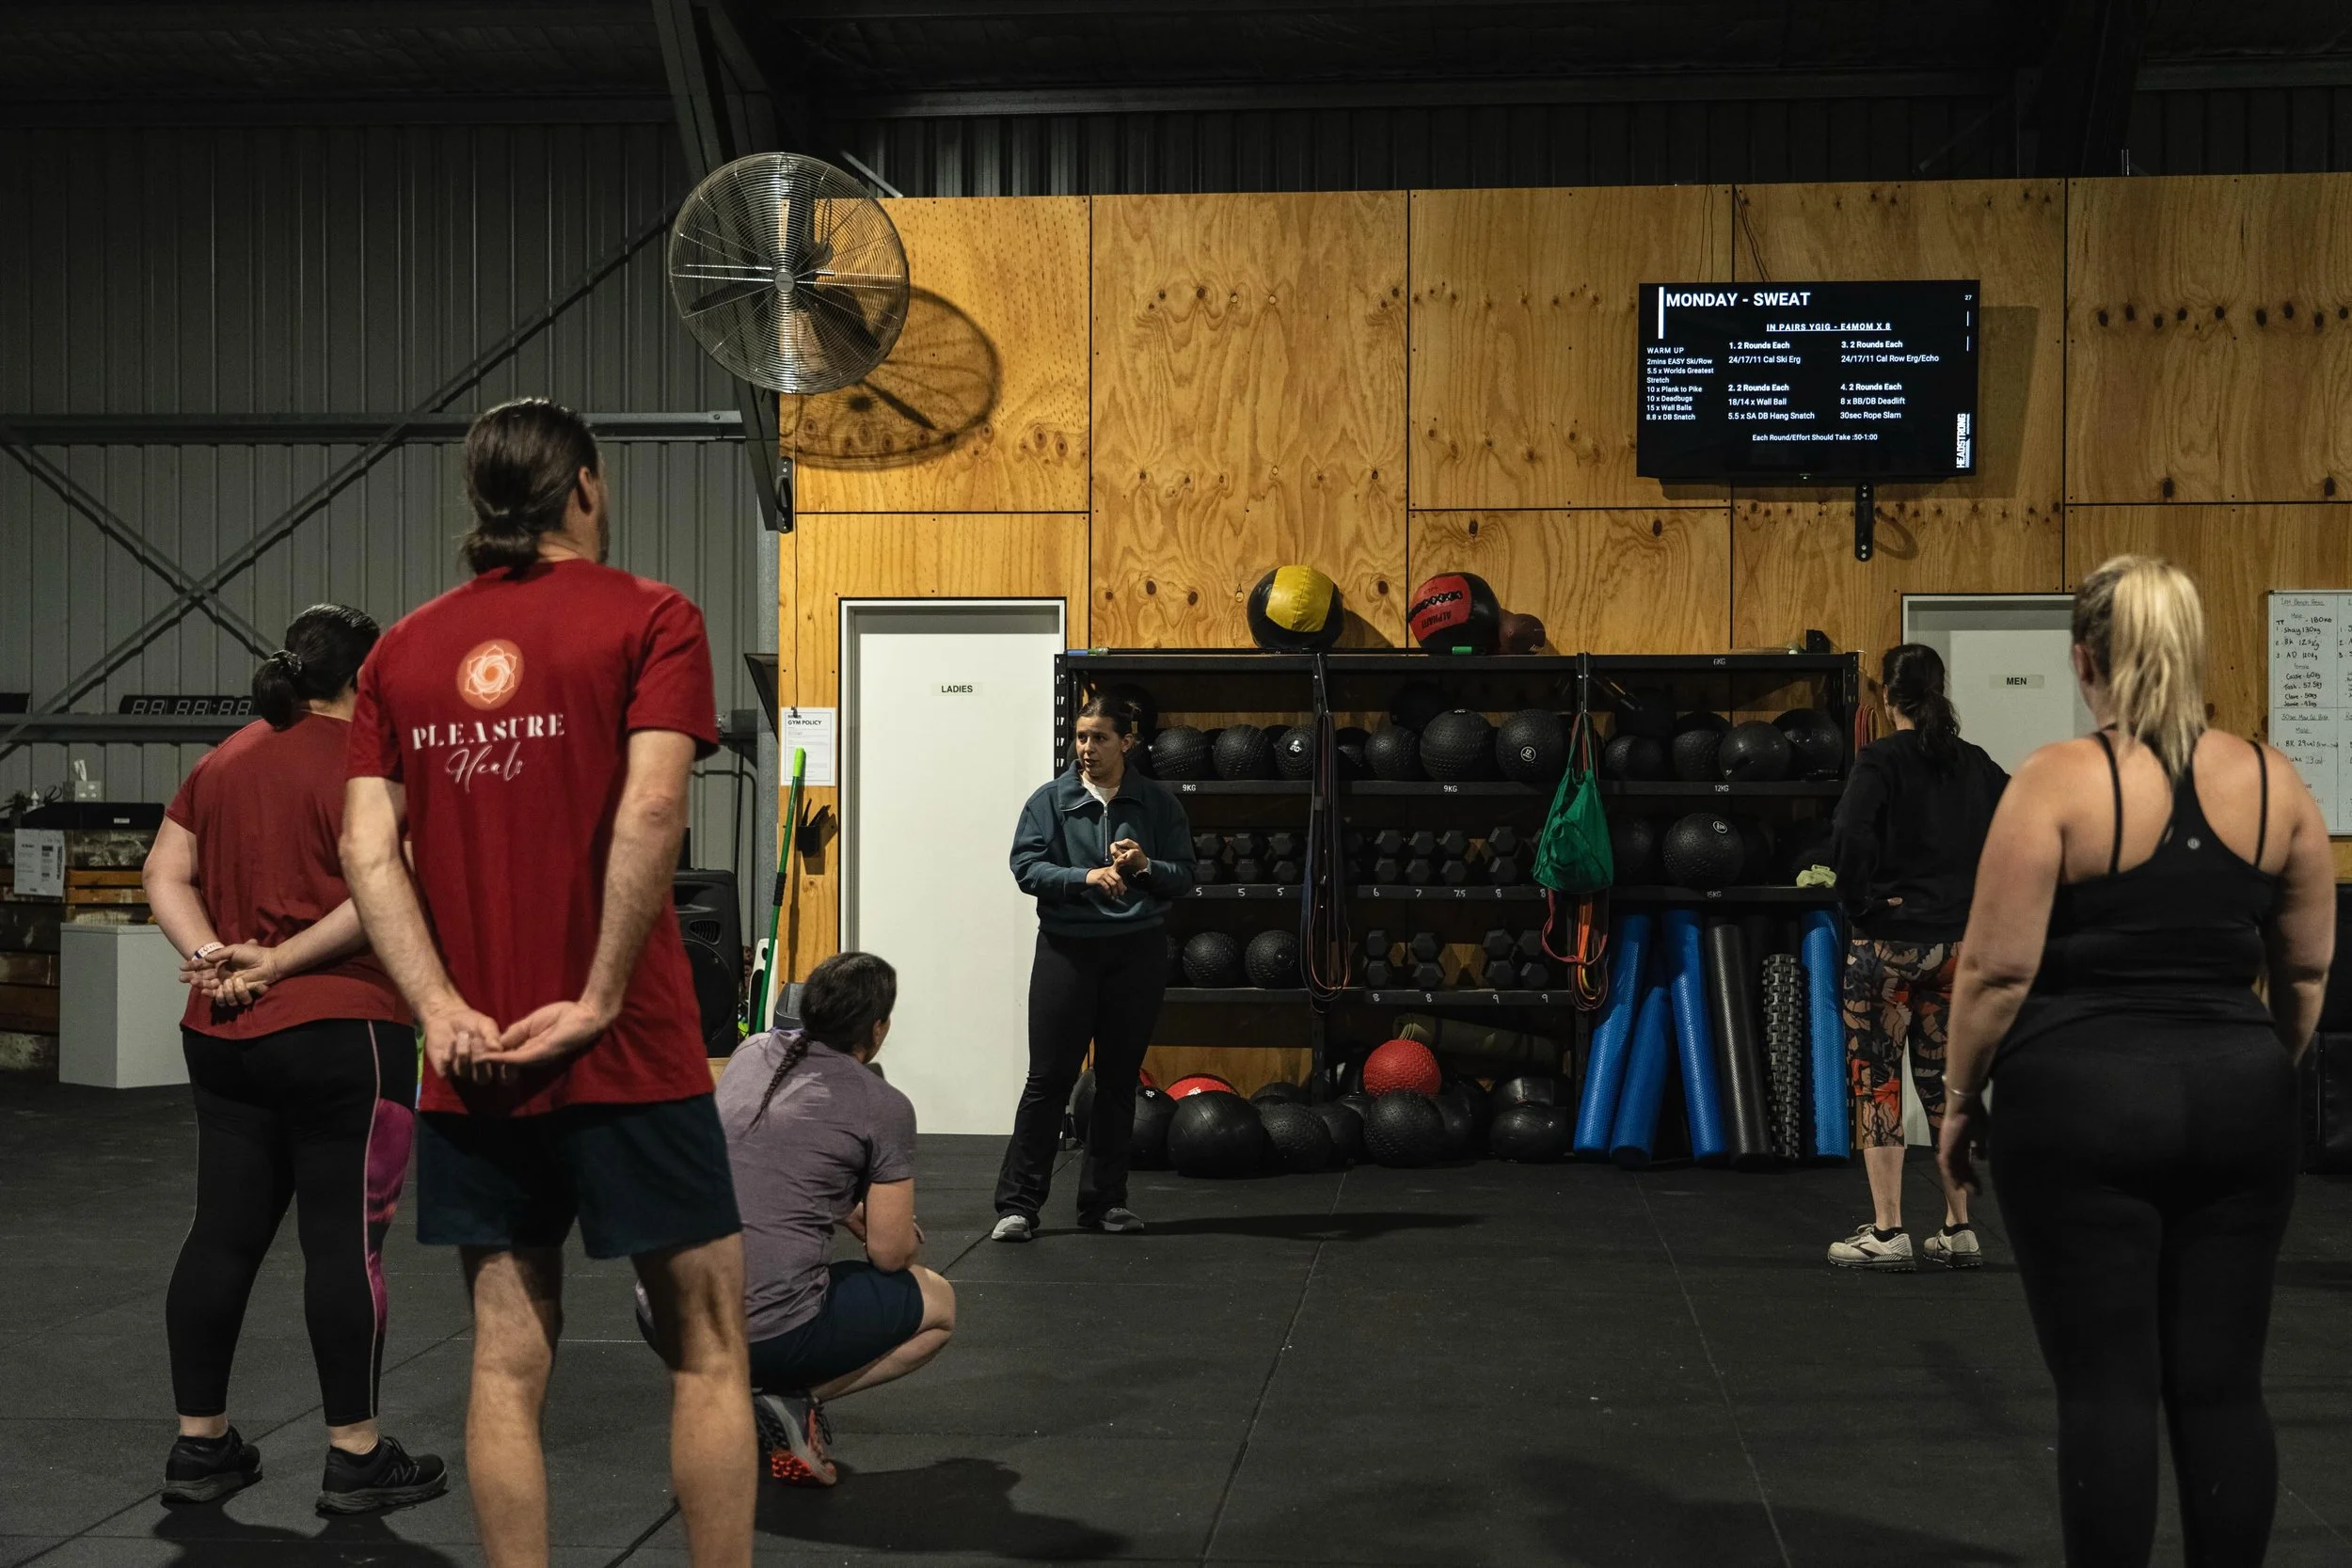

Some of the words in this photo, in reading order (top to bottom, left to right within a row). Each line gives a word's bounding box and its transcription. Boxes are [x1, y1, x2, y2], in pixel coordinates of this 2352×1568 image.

[1666, 293, 1738, 307] MONDAY
[1754, 293, 1811, 306] SWEAT
[1728, 356, 1761, 364] 24/17/11
[1788, 356, 1802, 365] Erg
[1841, 355, 1874, 363] 24/17/11
[1907, 355, 1940, 363] Erg/Echo
[1743, 384, 1771, 392] Rounds
[1661, 395, 1693, 404] Deadbugs
[1770, 412, 1788, 420] Hang
[1863, 412, 1882, 420] Rope
[1956, 413, 1966, 468] HEADSTRONG
[2006, 677, 2027, 686] MEN
[941, 685, 973, 693] LADIES
[412, 712, 564, 751] PLEASURE
[444, 741, 523, 794] Heals
[1443, 784, 1458, 793] 9KG
[1195, 887, 1202, 896] 5
[1237, 888, 1246, 896] 5
[1277, 887, 1285, 896] 5
[1373, 888, 1380, 897] 6
[1415, 889, 1422, 897] 7
[1495, 889, 1502, 897] 8
[1539, 888, 1547, 897] 8
[1372, 993, 1380, 1002] 8
[1425, 993, 1433, 1003] 8
[1492, 994, 1500, 1005] 9
[1541, 993, 1549, 1004] 9
